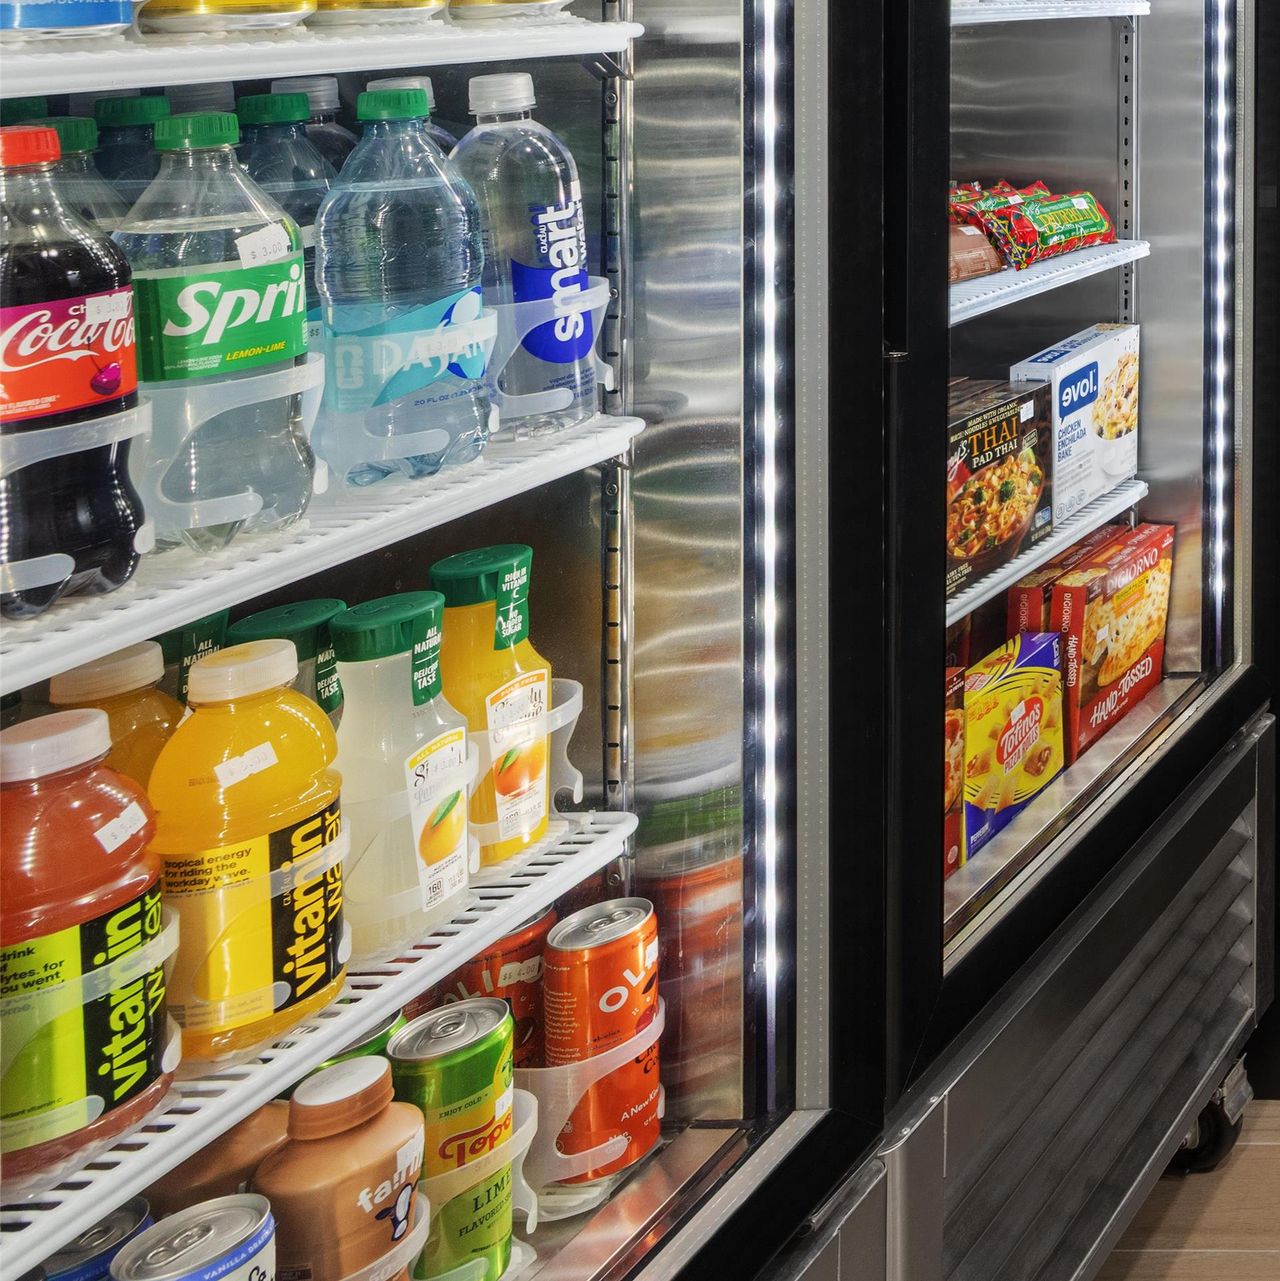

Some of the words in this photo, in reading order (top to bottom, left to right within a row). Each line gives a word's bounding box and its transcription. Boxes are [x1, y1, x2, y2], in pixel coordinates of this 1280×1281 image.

[261, 241, 283, 257] 3.00
[538, 201, 585, 342] smart
[225, 340, 287, 362] LEMON-LIME
[413, 399, 426, 407] 20
[426, 397, 438, 405] FL
[439, 394, 451, 402] OZ
[967, 415, 983, 428] MADE
[982, 410, 998, 420] WITH
[997, 400, 1019, 415] ORGANIC
[963, 421, 988, 438] NOODLES
[967, 416, 1019, 458] THAI
[1057, 419, 1083, 441] CHICKEN
[1057, 428, 1087, 452] ENCHILADA
[971, 449, 994, 469] PAD
[995, 440, 1019, 461] THAI
[1057, 446, 1073, 463] BAKE
[1106, 547, 1159, 595] DIGIORNO
[1061, 592, 1072, 634] DIGIORNO
[426, 626, 438, 639] ALL
[501, 624, 522, 638] SUGAR
[198, 639, 213, 652] ALL
[1066, 634, 1079, 688] HAND-TOSSED
[1089, 655, 1154, 728] HAND-TOSSED
[1000, 700, 1041, 756] Totino's
[164, 856, 205, 871] tropical
[207, 847, 253, 866] energy
[164, 868, 178, 878] for
[178, 864, 213, 880] riding
[215, 860, 238, 872] the
[164, 874, 211, 891] workday
[213, 868, 251, 883] wave.
[428, 880, 443, 895] 160
[284, 817, 327, 998] vitamin
[42, 958, 65, 973] for
[23, 972, 62, 990] went
[94, 901, 148, 1101] vitamin
[438, 1104, 463, 1120] ENJOY
[464, 1096, 483, 1109] COLD
[620, 1110, 630, 1123] A
[630, 1098, 650, 1115] New
[203, 1246, 249, 1281] VANILLA
